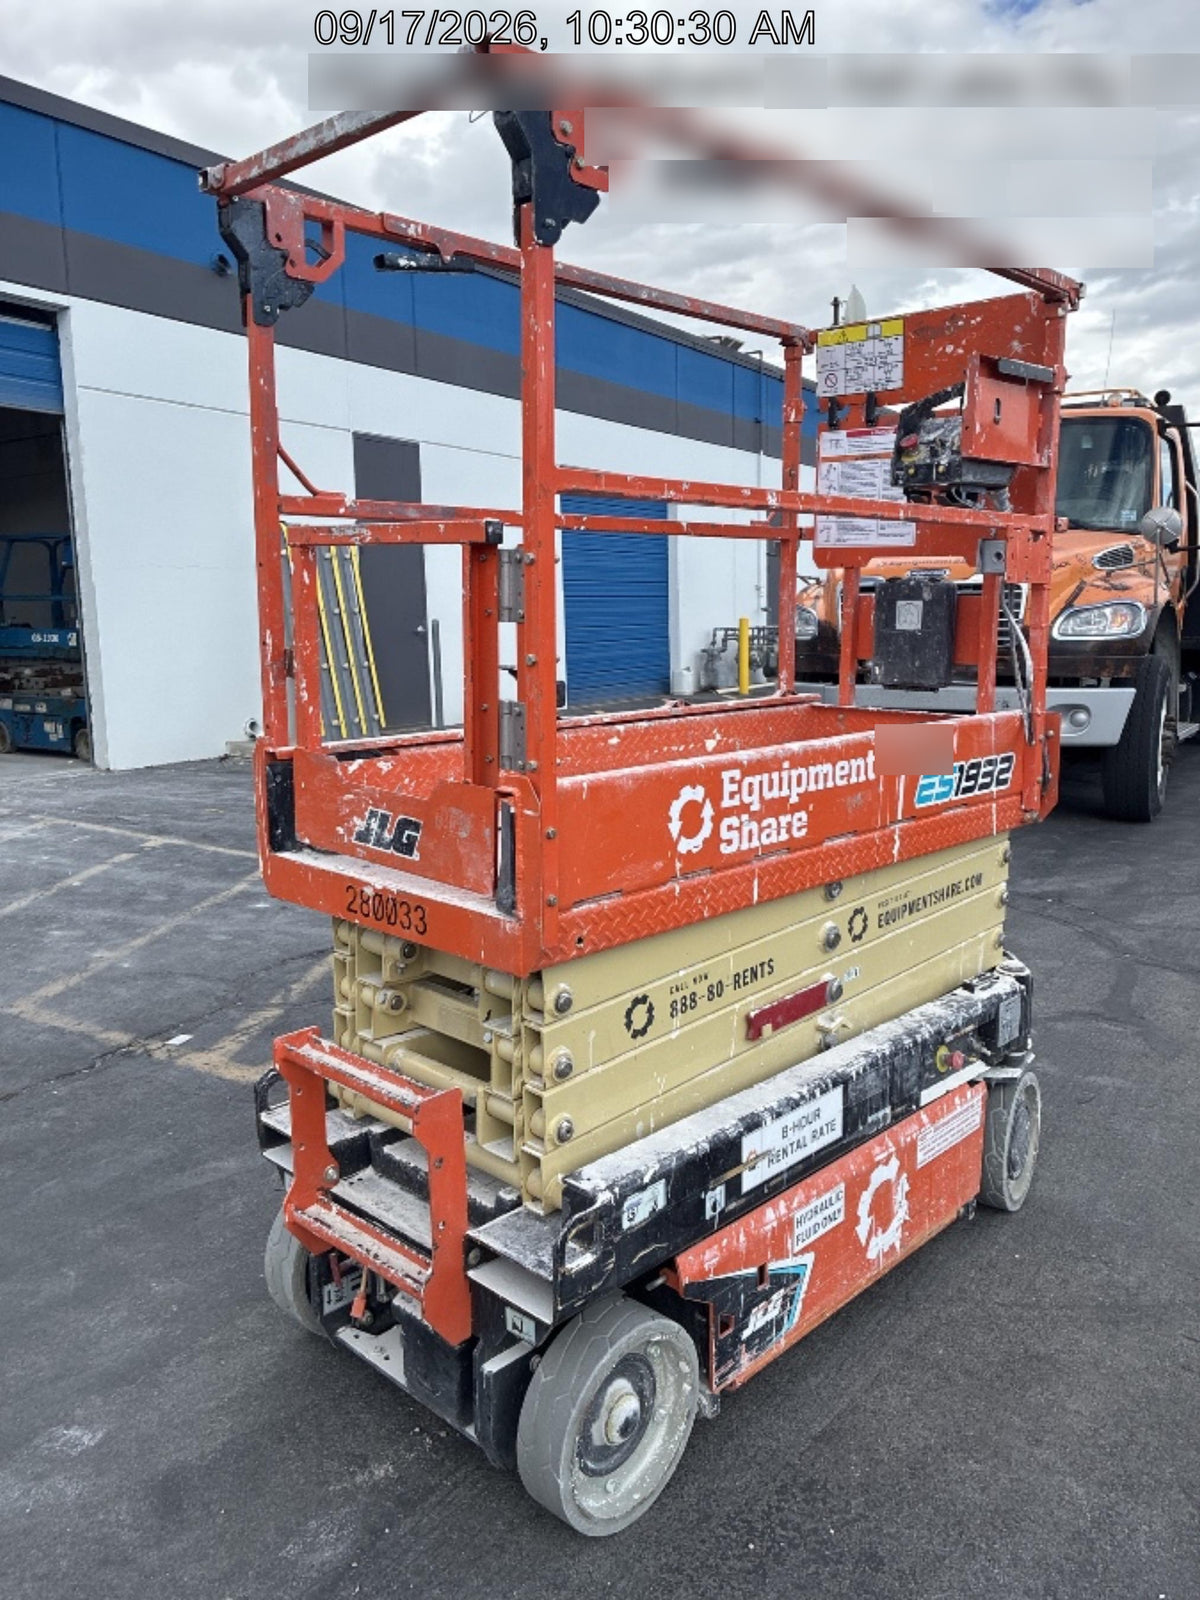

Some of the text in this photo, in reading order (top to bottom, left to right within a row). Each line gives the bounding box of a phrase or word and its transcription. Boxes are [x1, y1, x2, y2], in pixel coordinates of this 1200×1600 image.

[720, 749, 876, 812] Equipment
[915, 752, 1016, 809] ES1932
[352, 807, 423, 861] JLG
[719, 810, 808, 854] Share
[345, 885, 428, 936] 280033
[877, 872, 983, 929] EQUIPMENTSHARE.COM
[669, 957, 775, 1019] 888-80-RENTS
[767, 1118, 837, 1169] RENTAL RATE
